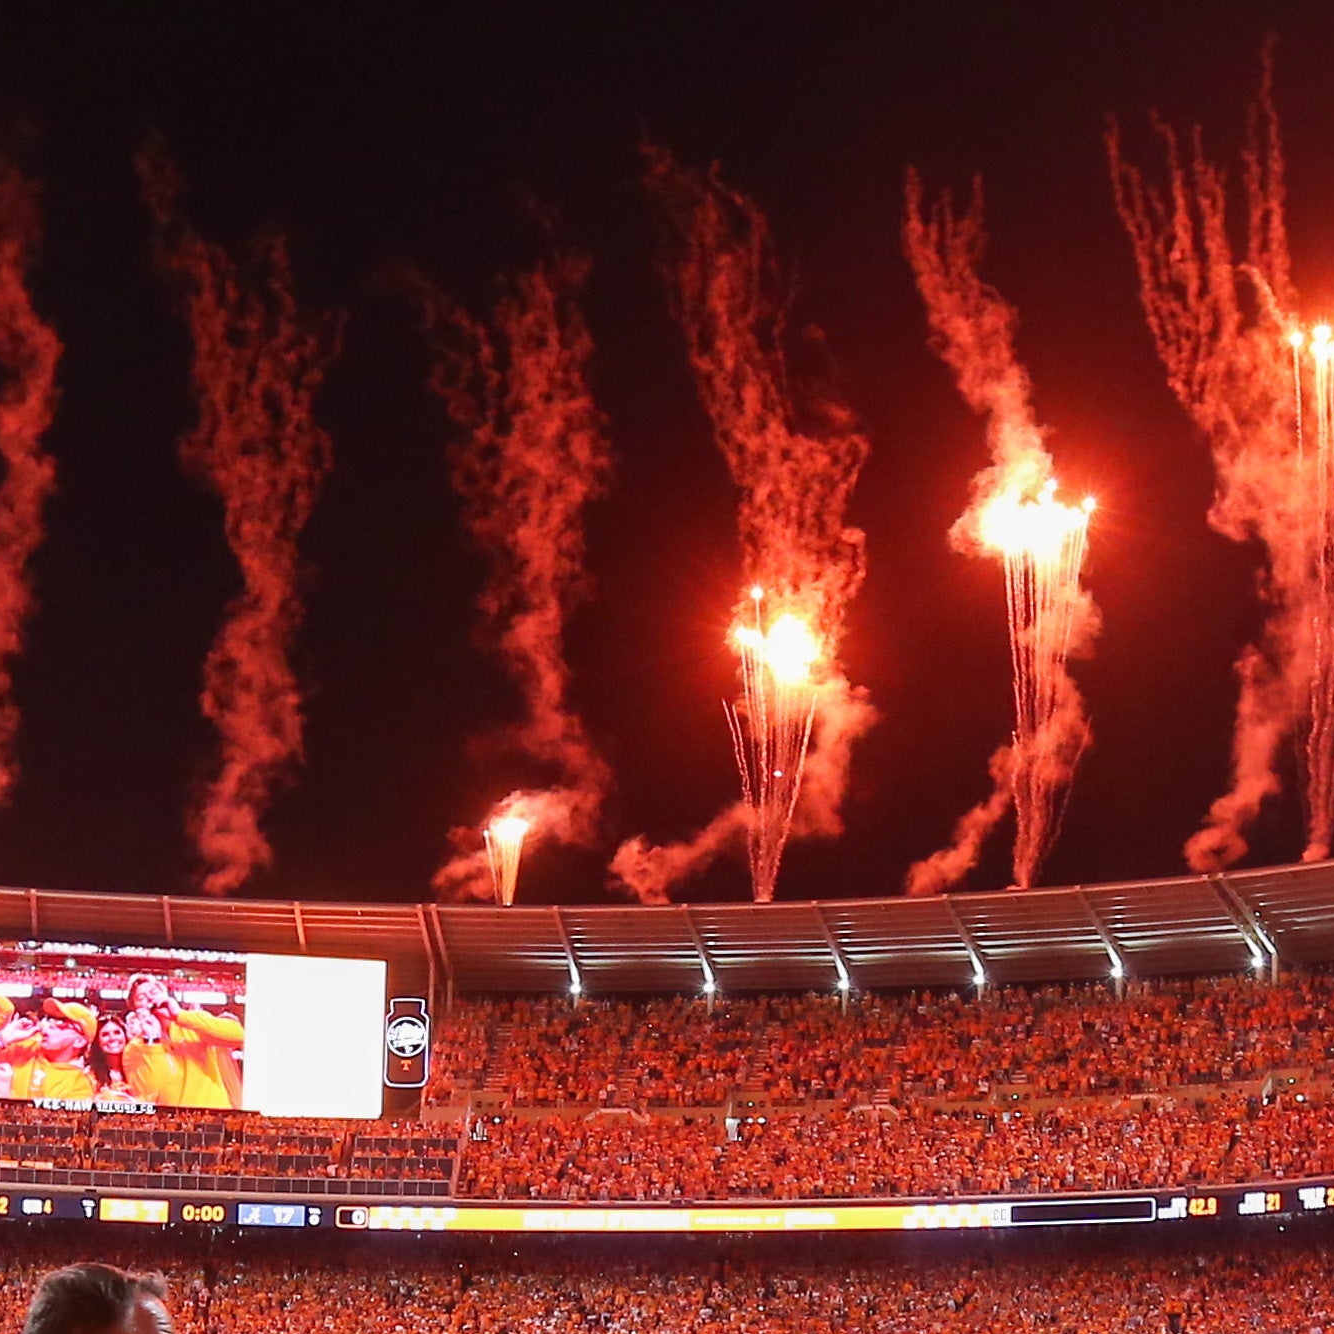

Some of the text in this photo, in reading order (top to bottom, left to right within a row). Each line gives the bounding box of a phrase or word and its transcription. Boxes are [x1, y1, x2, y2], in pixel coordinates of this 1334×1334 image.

[43, 1199, 52, 1214] 4
[1189, 1198, 1216, 1215] 42.9
[1267, 1193, 1280, 1211] 21
[182, 1204, 225, 1222] 0:00
[273, 1207, 294, 1224] 17
